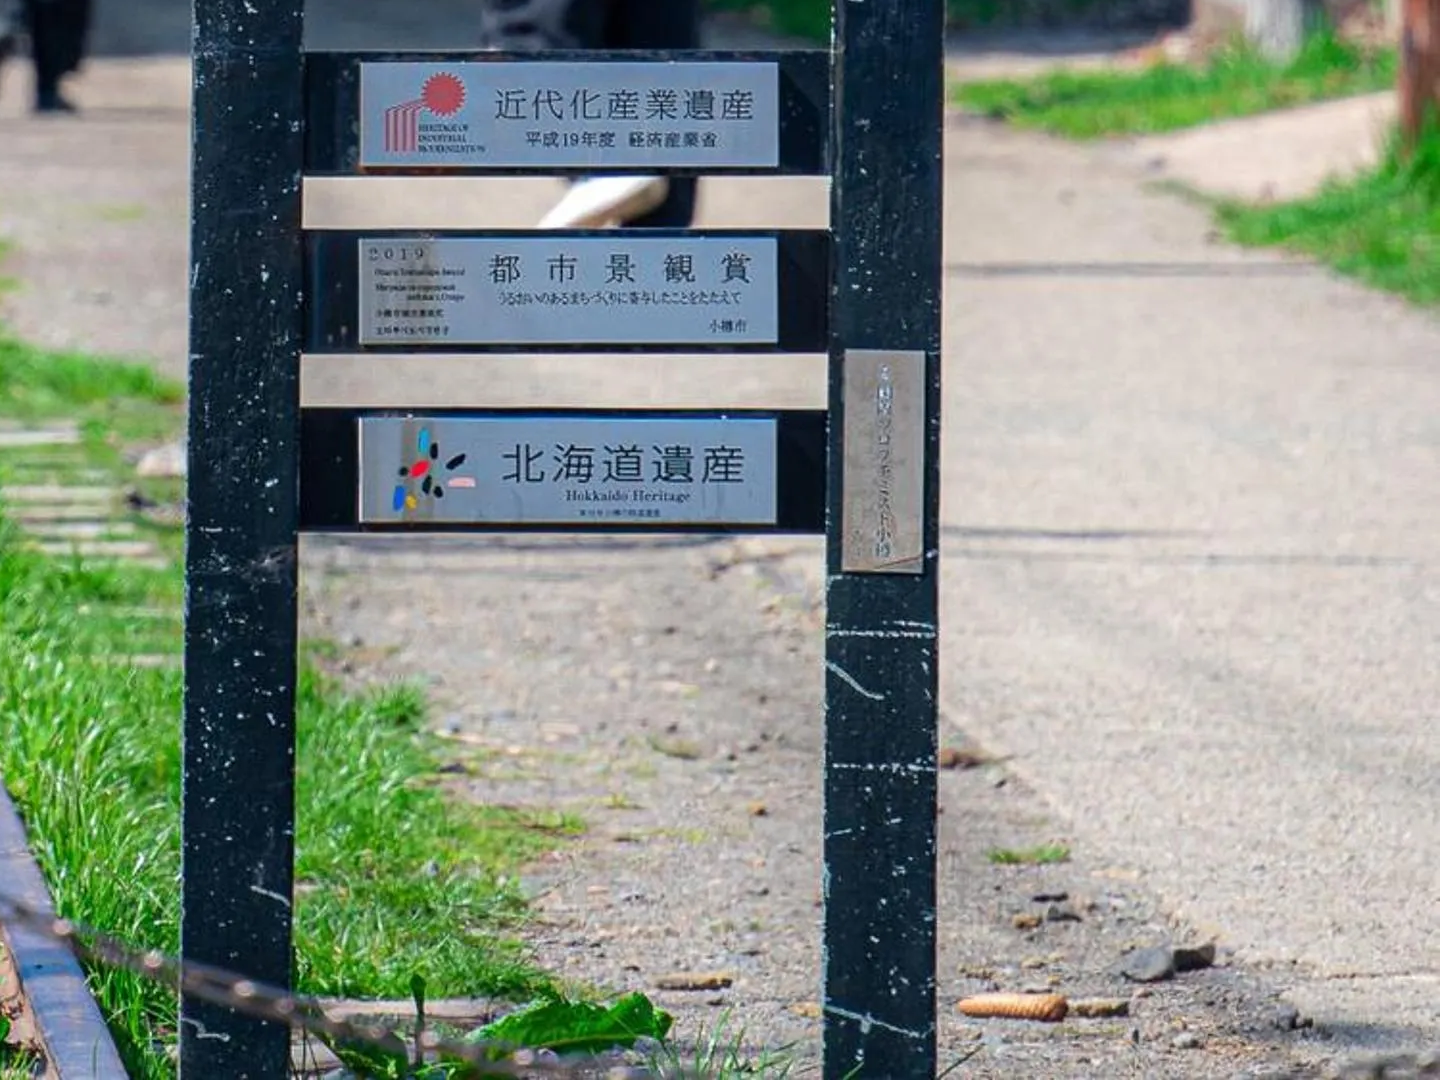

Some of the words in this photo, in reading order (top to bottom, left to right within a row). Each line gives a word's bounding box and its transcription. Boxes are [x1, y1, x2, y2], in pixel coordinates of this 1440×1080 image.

[494, 88, 755, 121] 近代化産業遺産
[525, 131, 616, 149] 平成19年度
[368, 247, 424, 261] 2019
[489, 252, 751, 284] 都市景観賞
[502, 443, 745, 483] 北海道遺産
